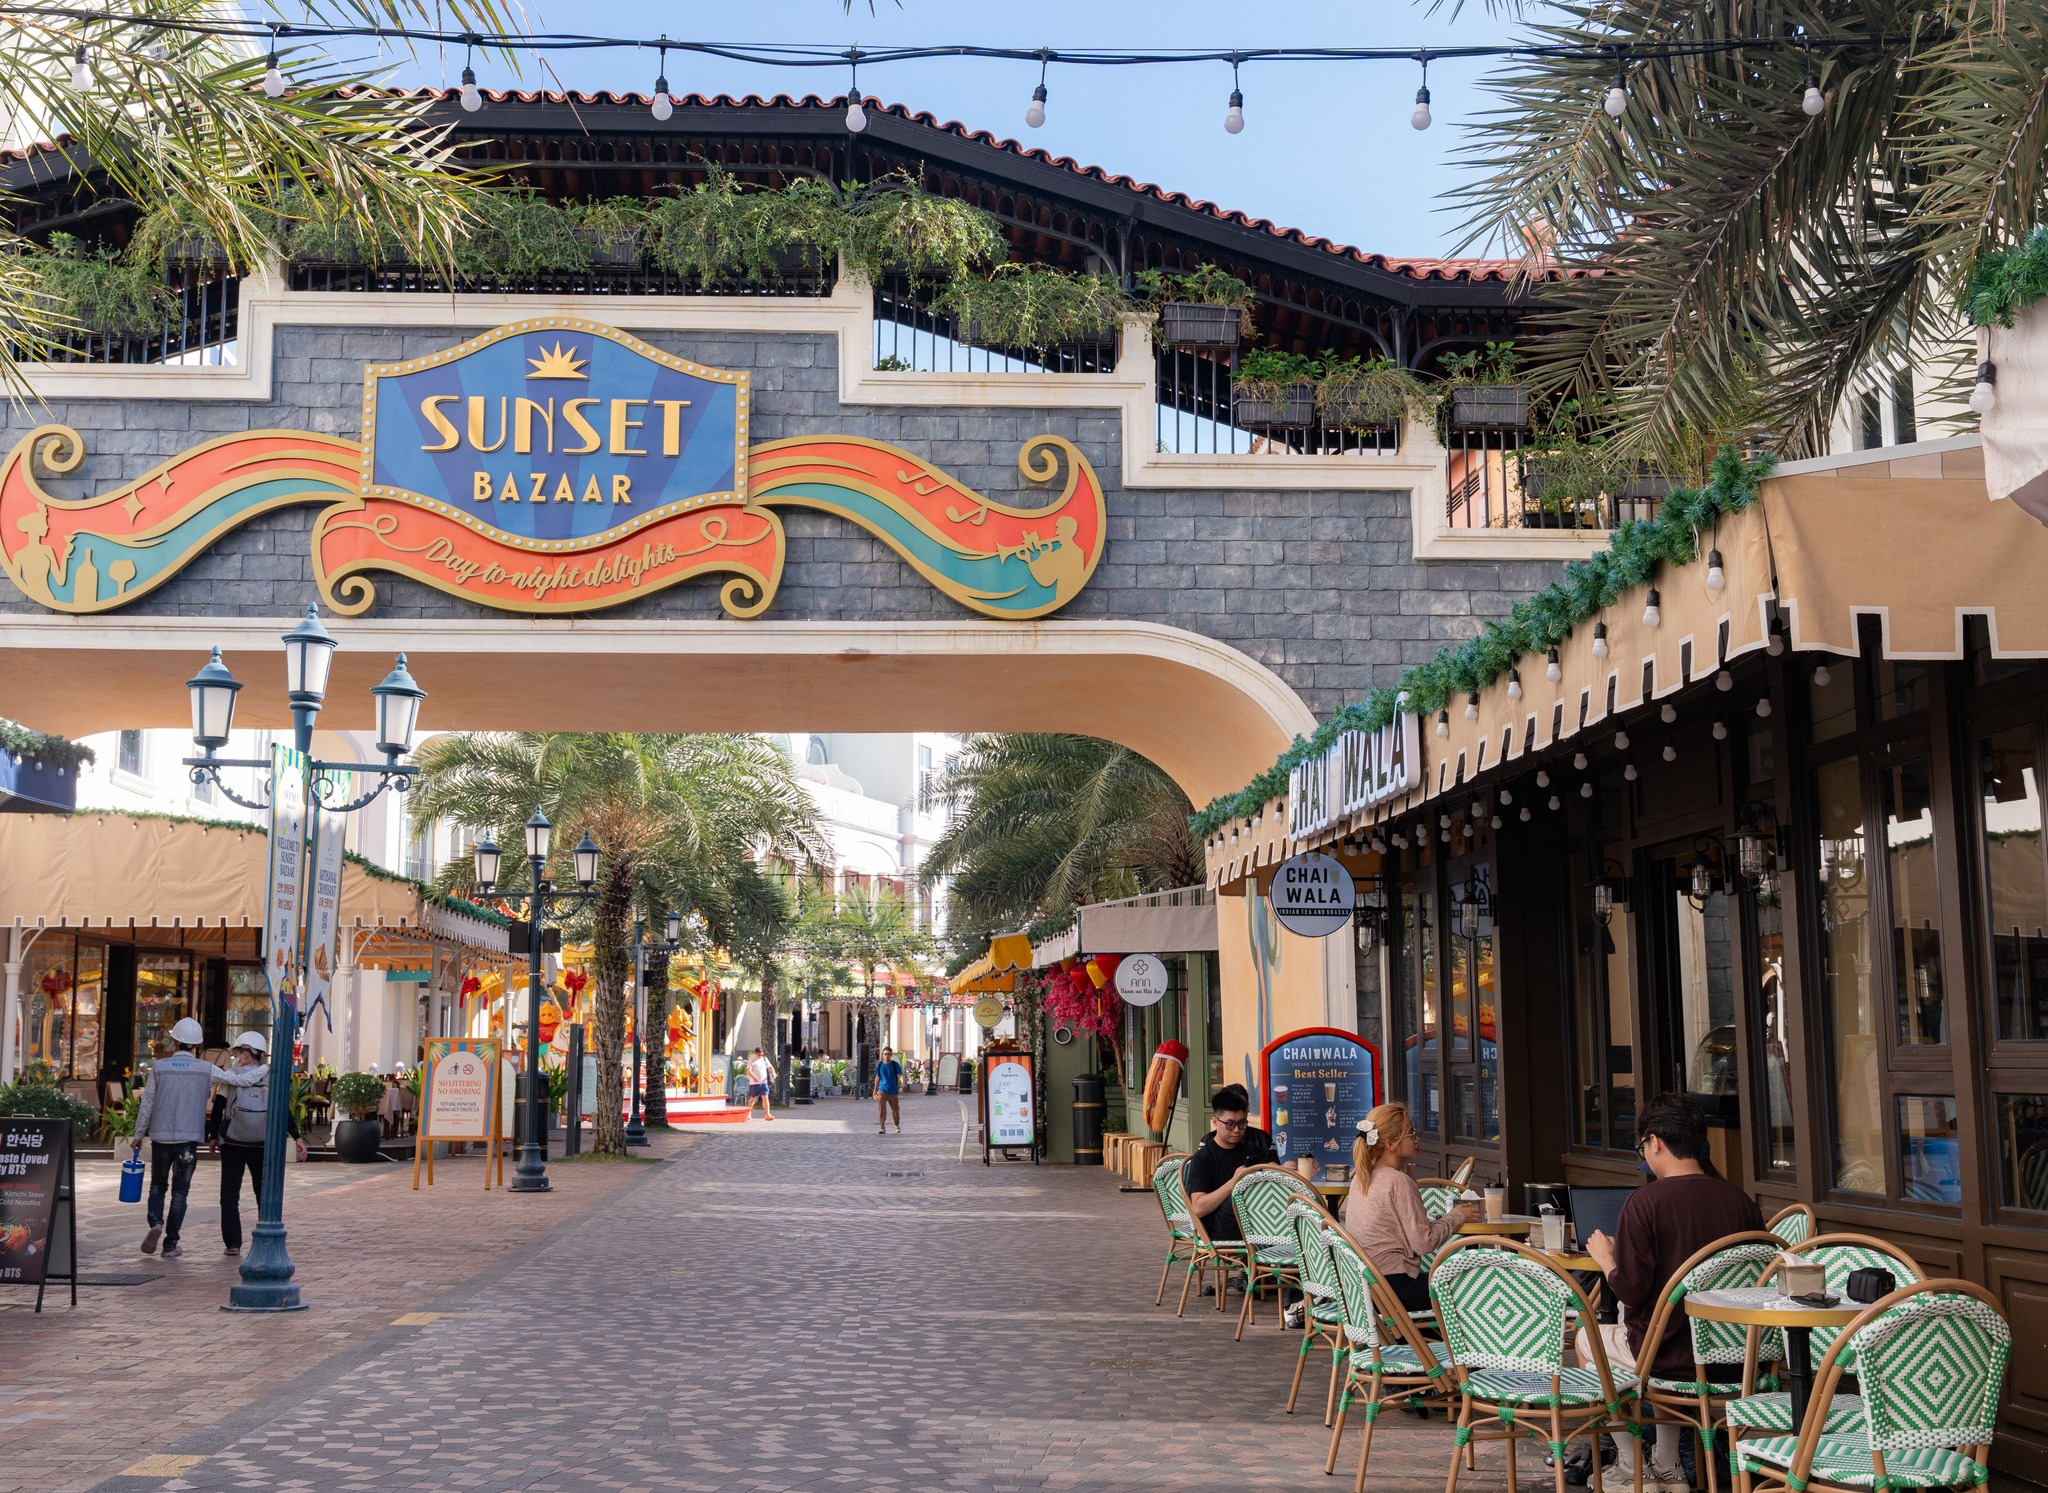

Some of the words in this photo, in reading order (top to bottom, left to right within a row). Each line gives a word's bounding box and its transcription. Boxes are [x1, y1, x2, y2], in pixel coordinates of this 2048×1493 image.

[420, 395, 691, 457] SUNSET
[473, 472, 632, 504] BAZAAR
[424, 537, 481, 584] Day
[482, 562, 508, 584] to
[509, 562, 580, 599] night
[584, 543, 676, 588] delights
[1342, 692, 1408, 815] WALA
[281, 851, 296, 864] SUNSET
[280, 864, 294, 878] BAZAAR
[1286, 867, 1328, 884] CHAI
[1286, 888, 1341, 904] WALA
[1284, 1048, 1311, 1060] CHAI
[1322, 1048, 1358, 1059] WALA
[1294, 1069, 1316, 1078] Best
[1318, 1068, 1348, 1078] Seller
[6, 1134, 44, 1148] 한식당
[0, 1154, 19, 1163] aste
[21, 1153, 49, 1164] Loved
[8, 1164, 27, 1175] BTS
[4, 1268, 21, 1278] BTS
